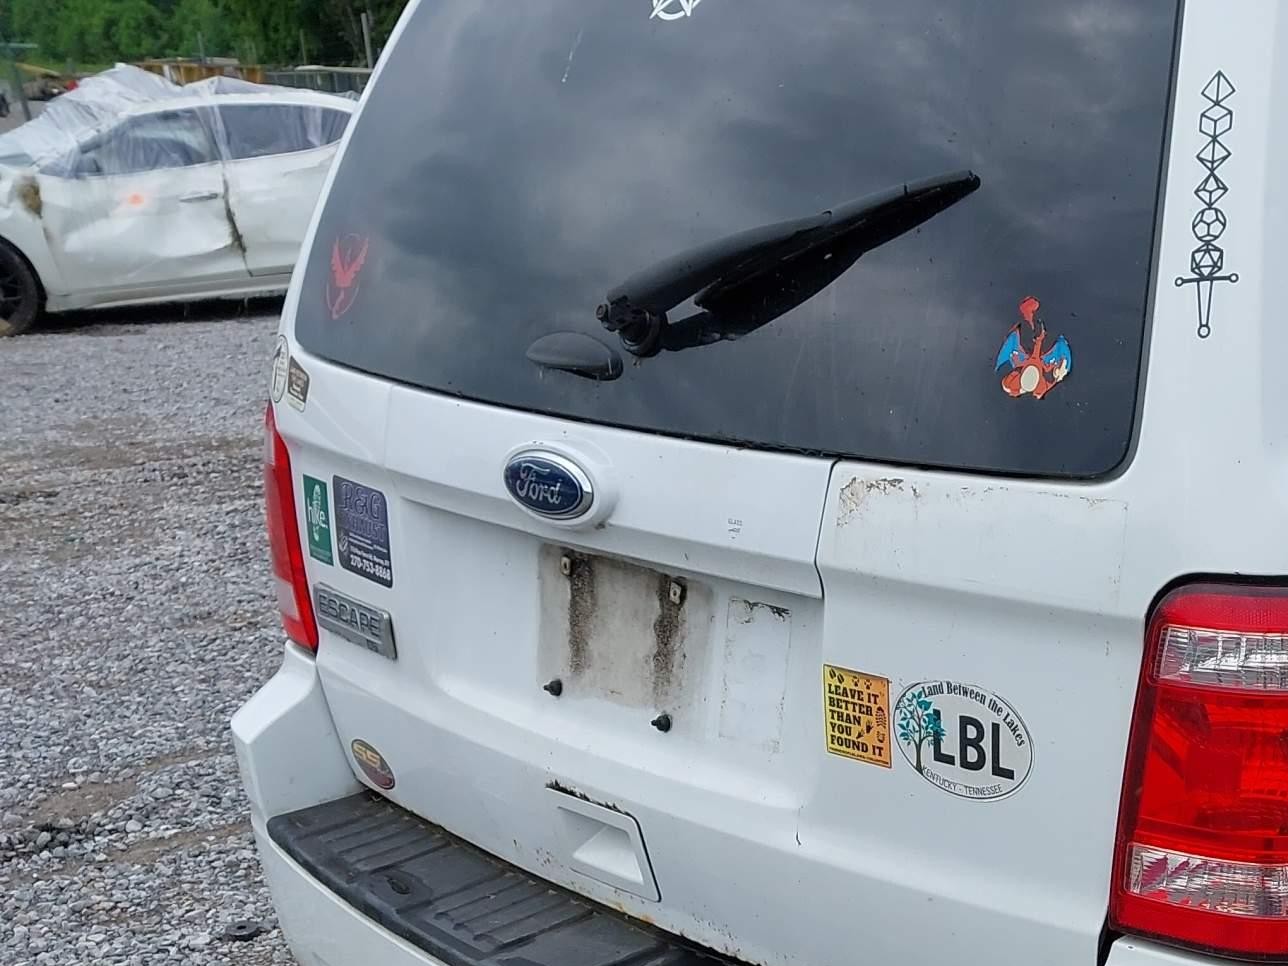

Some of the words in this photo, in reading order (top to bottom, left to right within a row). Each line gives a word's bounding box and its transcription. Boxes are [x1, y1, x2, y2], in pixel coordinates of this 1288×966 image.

[516, 462, 562, 505] Ford
[318, 593, 380, 638] ESCAPE
[828, 683, 864, 702] LEAVE
[867, 692, 880, 705] IT
[828, 696, 873, 716] BETTER
[829, 708, 861, 726] THAN
[921, 682, 944, 698] Land
[946, 680, 987, 706] Between
[988, 698, 1003, 717] the
[1002, 713, 1025, 748] Lakes
[829, 721, 852, 737] YOU
[830, 734, 869, 753] FOUND
[872, 744, 884, 757] IT
[932, 708, 1015, 780] LBL
[921, 765, 958, 792] KENTUCKY
[964, 784, 1004, 796] TENNESSEE
